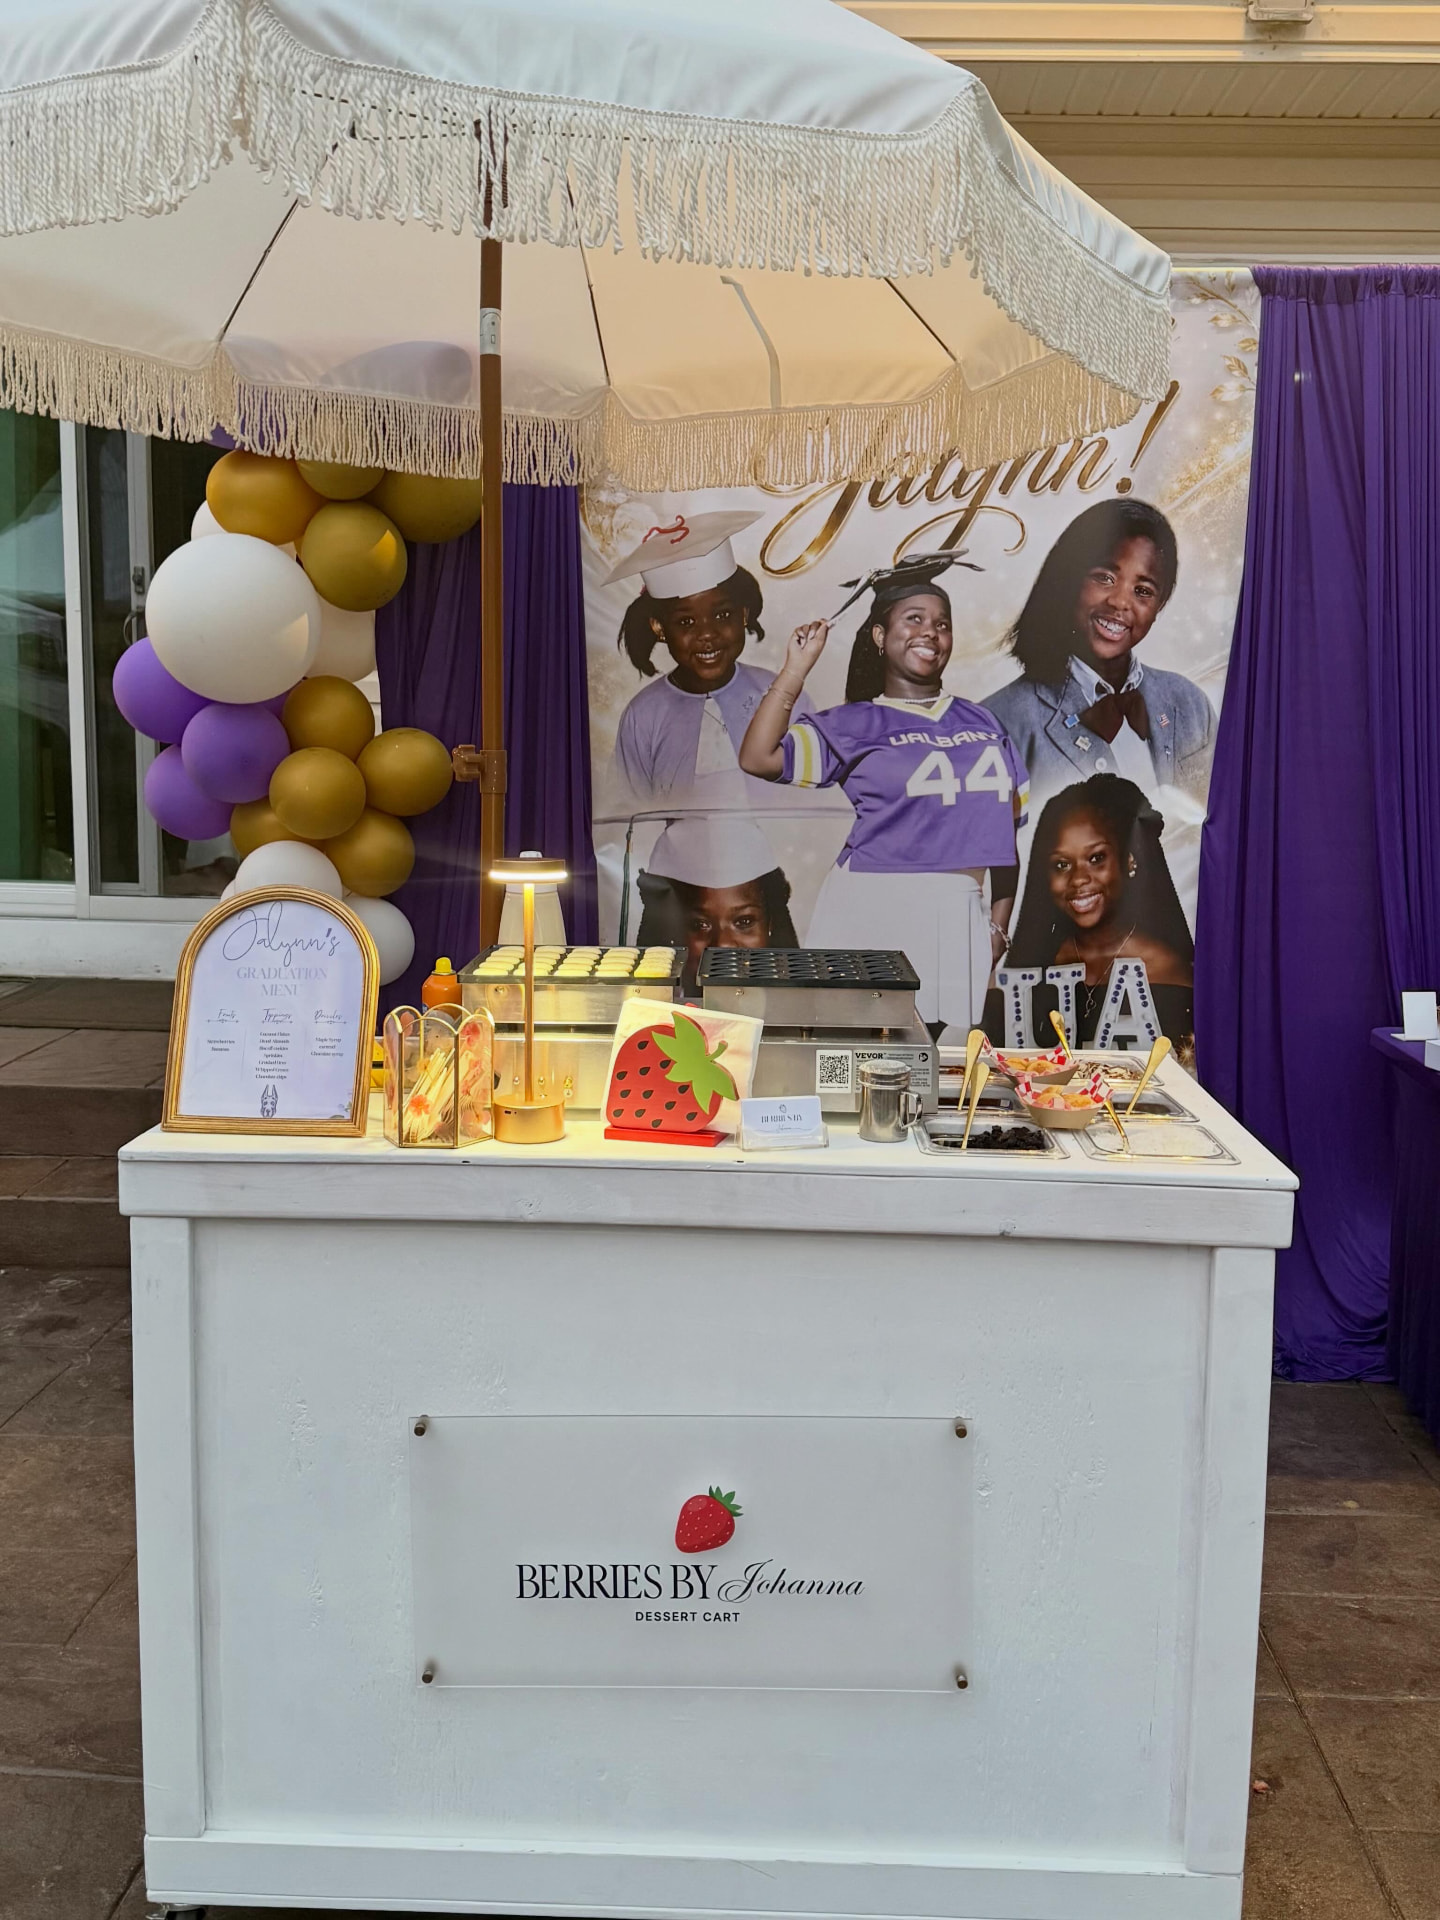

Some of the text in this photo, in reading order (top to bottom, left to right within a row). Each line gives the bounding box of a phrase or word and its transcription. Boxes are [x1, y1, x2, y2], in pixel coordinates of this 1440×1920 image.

[889, 730, 999, 748] UALBANY
[906, 745, 1013, 806] 44
[222, 900, 340, 967] Jalynn's
[236, 966, 328, 980] GRADUATION
[261, 983, 303, 997] MENU
[855, 1052, 883, 1060] VEVOR
[515, 1559, 867, 1604] BERRIES BY Johanna
[635, 1611, 741, 1623] DESSERT CART
